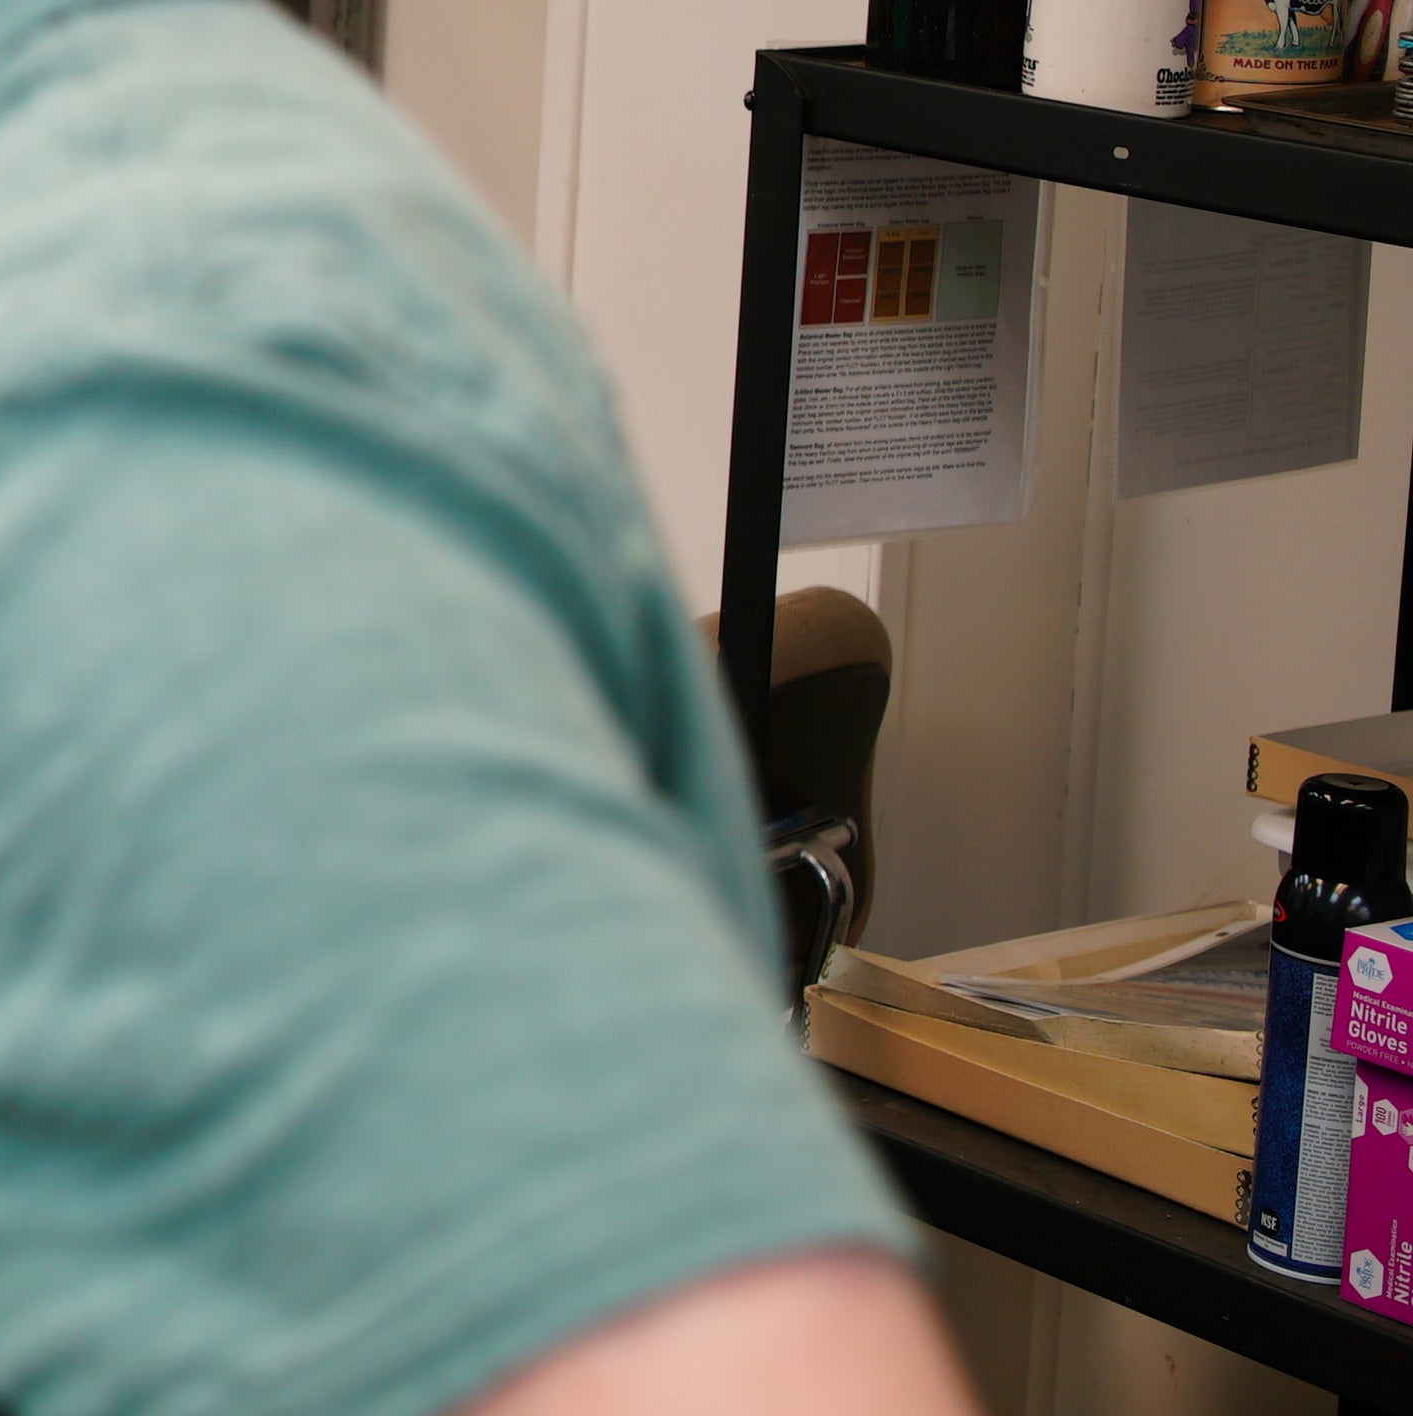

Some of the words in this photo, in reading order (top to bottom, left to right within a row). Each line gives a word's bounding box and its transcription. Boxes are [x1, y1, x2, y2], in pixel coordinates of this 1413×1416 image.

[1233, 58, 1271, 70] MADE
[1274, 59, 1293, 70] ON
[1297, 59, 1317, 70] THE
[1353, 990, 1380, 1007] Medical
[1350, 999, 1408, 1035] Nitrile
[1348, 1020, 1408, 1054] Gloves
[1346, 1040, 1378, 1058] POWDER
[1379, 1051, 1400, 1065] FREE
[1356, 1094, 1365, 1124] Large
[1375, 1106, 1387, 1125] 100
[1261, 1211, 1278, 1230] NSF
[1394, 1241, 1413, 1305] Nitrile
